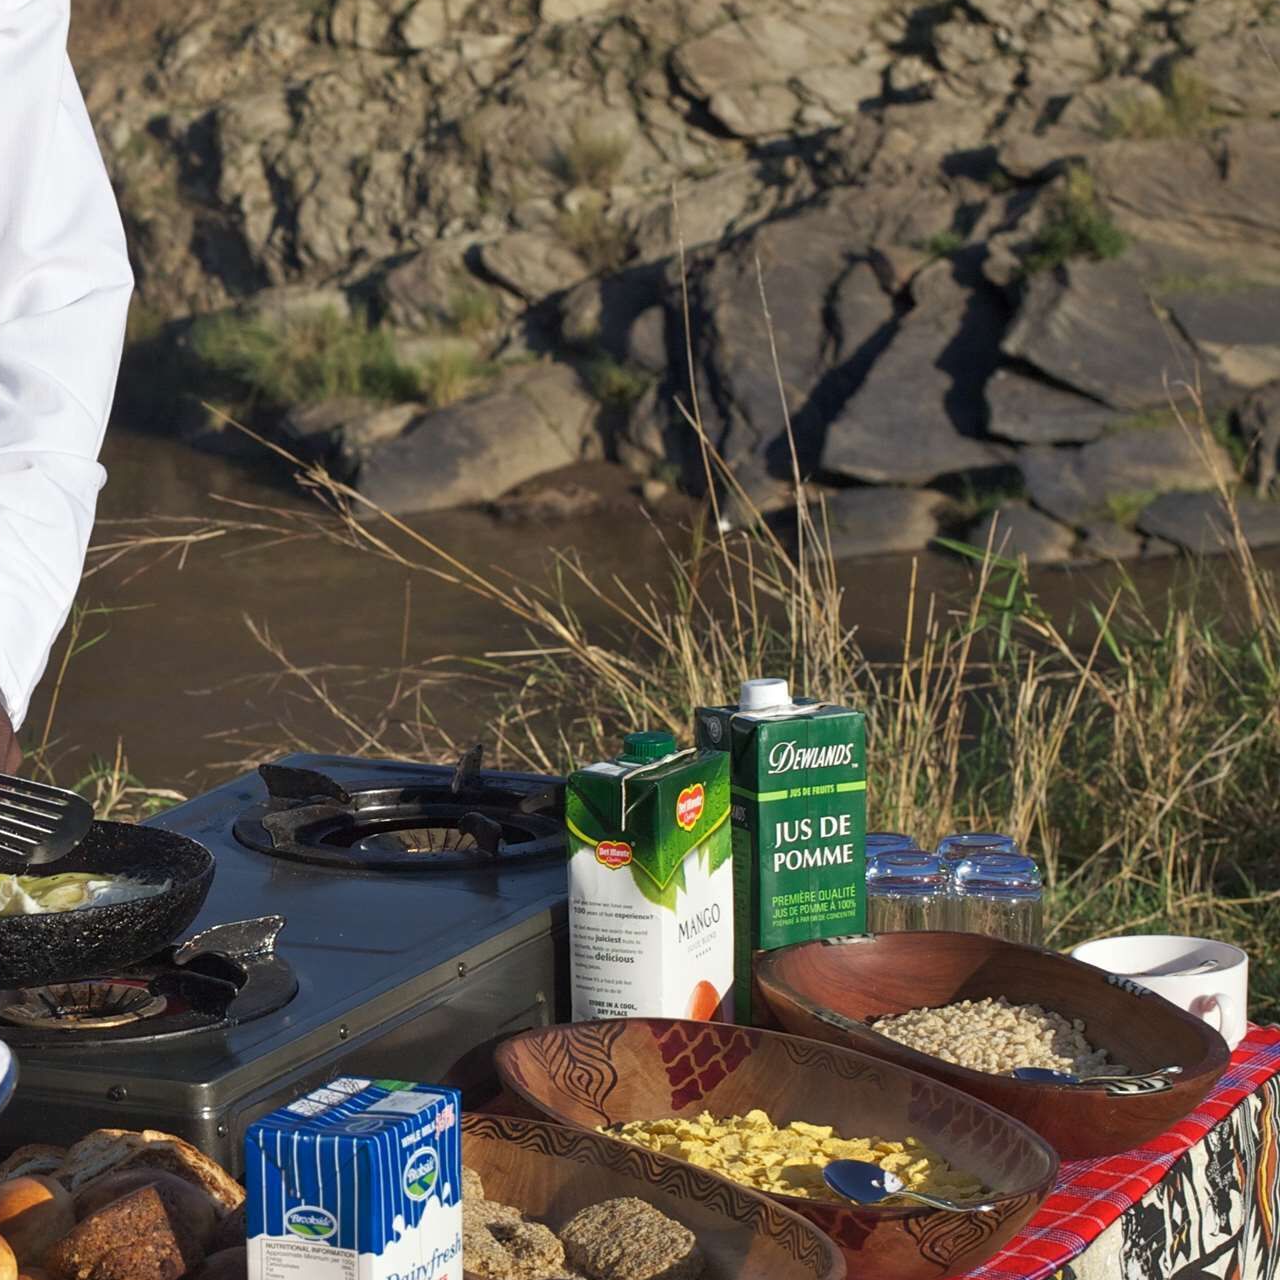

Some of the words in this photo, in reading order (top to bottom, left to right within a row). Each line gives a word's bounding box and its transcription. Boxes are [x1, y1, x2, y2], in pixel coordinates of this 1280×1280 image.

[768, 740, 855, 775] DEWLANDS
[789, 788, 801, 798] JUS
[802, 786, 811, 796] DE
[811, 784, 835, 795] FRUITS
[775, 818, 813, 849] JUS
[820, 814, 851, 838] DE
[599, 847, 610, 856] Del
[610, 848, 630, 858] Monte
[773, 843, 854, 873] POMME
[772, 889, 816, 908] PREMIÈRE
[818, 882, 856, 901] QUALITÉ
[772, 907, 788, 919] JUS
[789, 905, 799, 916] DE
[799, 902, 828, 914] POMME
[837, 899, 856, 910] 100%
[678, 903, 721, 943] MANGO
[595, 951, 635, 964] delicious
[265, 1242, 310, 1253] NUTRITIONAL
